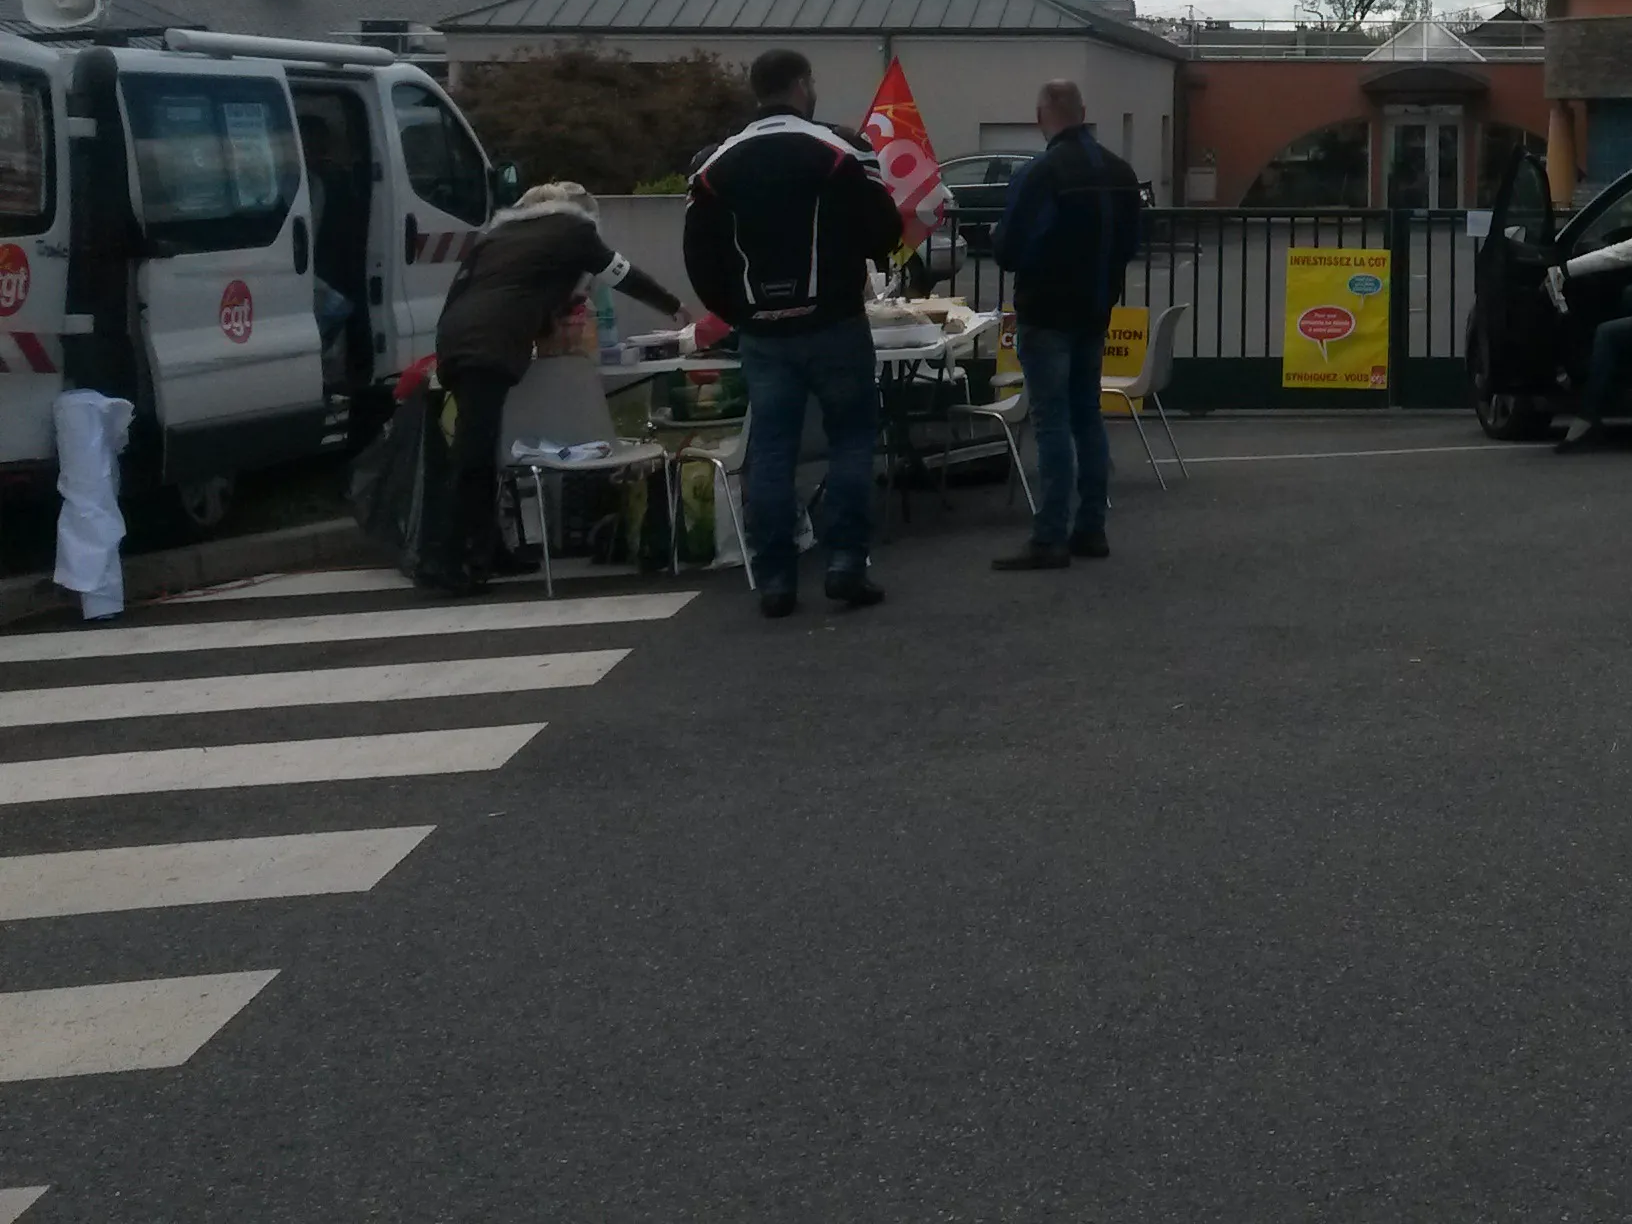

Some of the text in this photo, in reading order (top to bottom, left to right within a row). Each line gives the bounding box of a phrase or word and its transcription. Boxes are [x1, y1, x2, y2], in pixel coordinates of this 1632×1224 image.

[1290, 255, 1387, 268] INVESTISSEZ LA CGT
[0, 266, 27, 308] gt
[221, 297, 251, 337] cgt
[1285, 372, 1369, 383] SYNDIQUEZ VOUS
